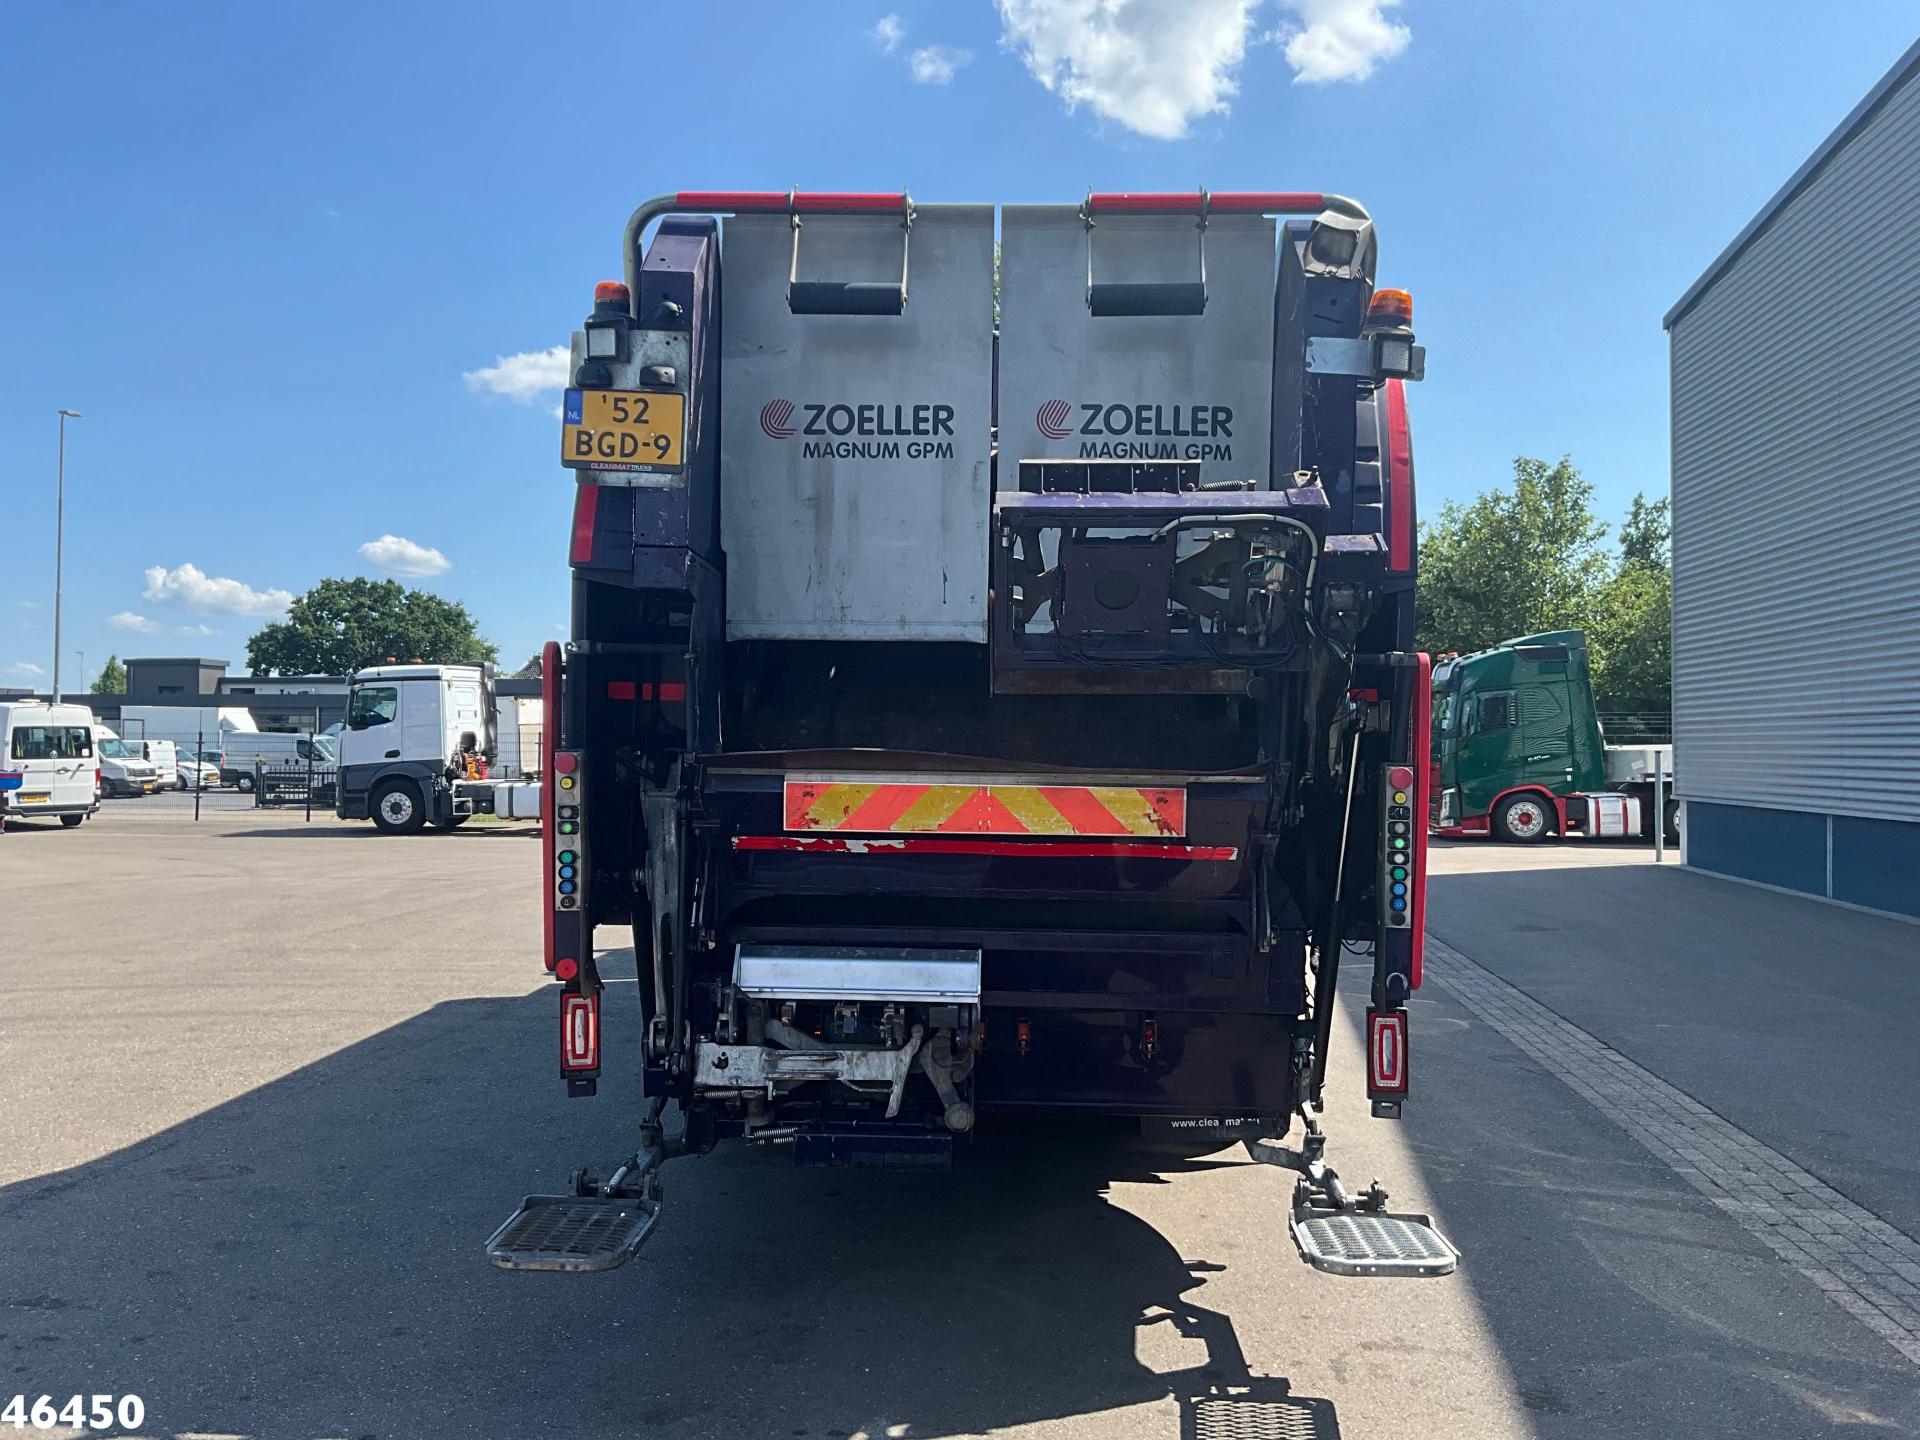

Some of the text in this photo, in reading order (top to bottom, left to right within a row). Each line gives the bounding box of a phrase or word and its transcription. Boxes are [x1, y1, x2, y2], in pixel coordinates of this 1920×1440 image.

[568, 411, 581, 420] NL
[612, 396, 650, 424] 52
[803, 404, 955, 436] ZOELLER
[1080, 404, 1233, 438] ZOELLER
[575, 430, 671, 460] BGD-9
[802, 442, 954, 459] MAGNUM GPM
[1079, 442, 1232, 461] MAGNUM GPM
